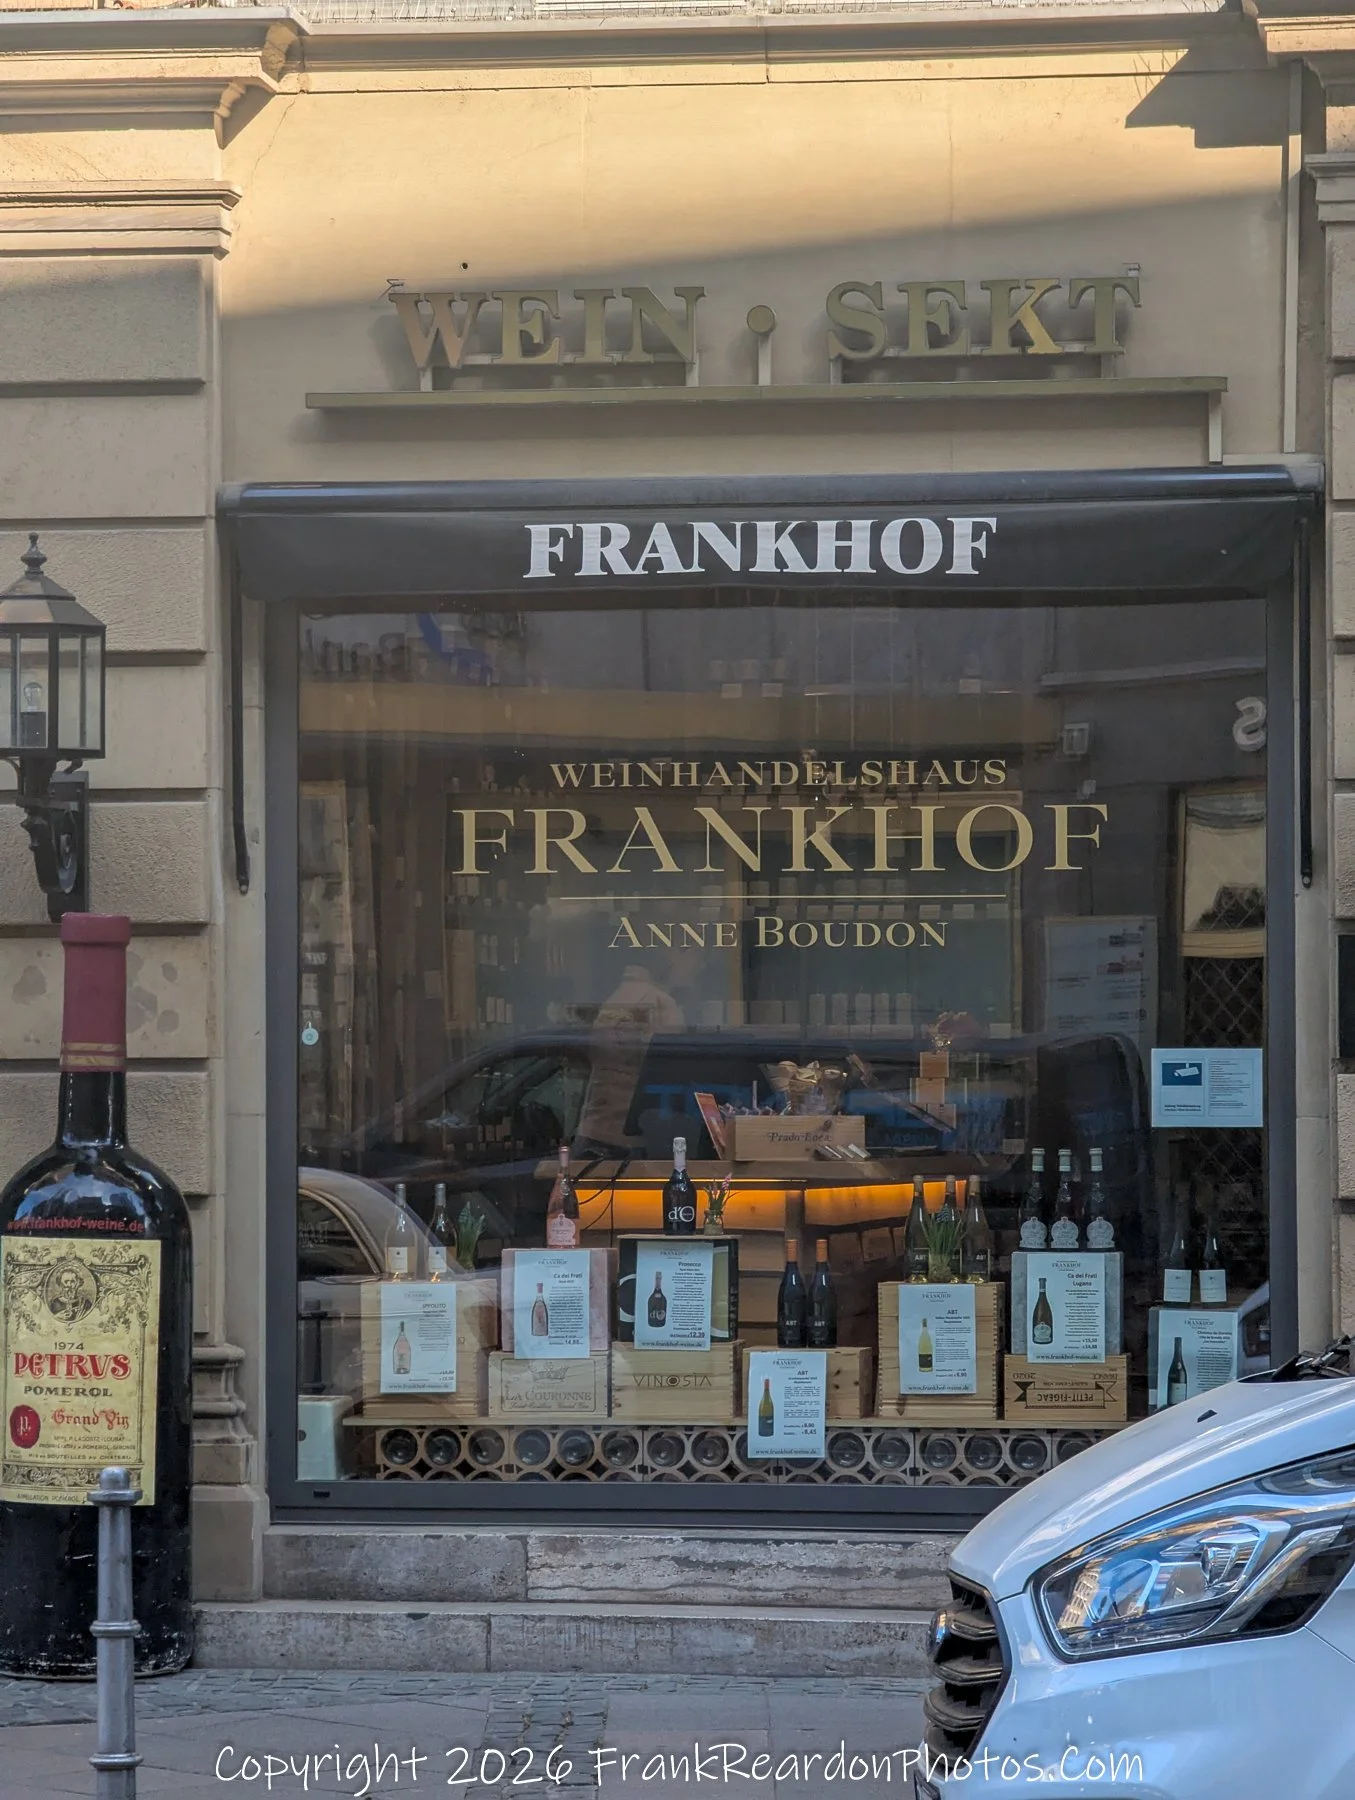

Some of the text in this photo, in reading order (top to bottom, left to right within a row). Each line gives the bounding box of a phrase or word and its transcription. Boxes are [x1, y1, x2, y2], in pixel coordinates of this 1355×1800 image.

[388, 275, 1142, 370] WEIN SEKT
[522, 516, 998, 579] FRANKHOF
[550, 758, 1007, 790] WEINHANDELSHAUS
[452, 802, 1109, 877] FRANKHOF
[7, 1216, 145, 1233] www.frankhof-weine.de
[54, 1341, 85, 1351] 1974
[24, 1385, 113, 1397] POMEROL
[1037, 1393, 1094, 1402] PETIT-FIGEAC
